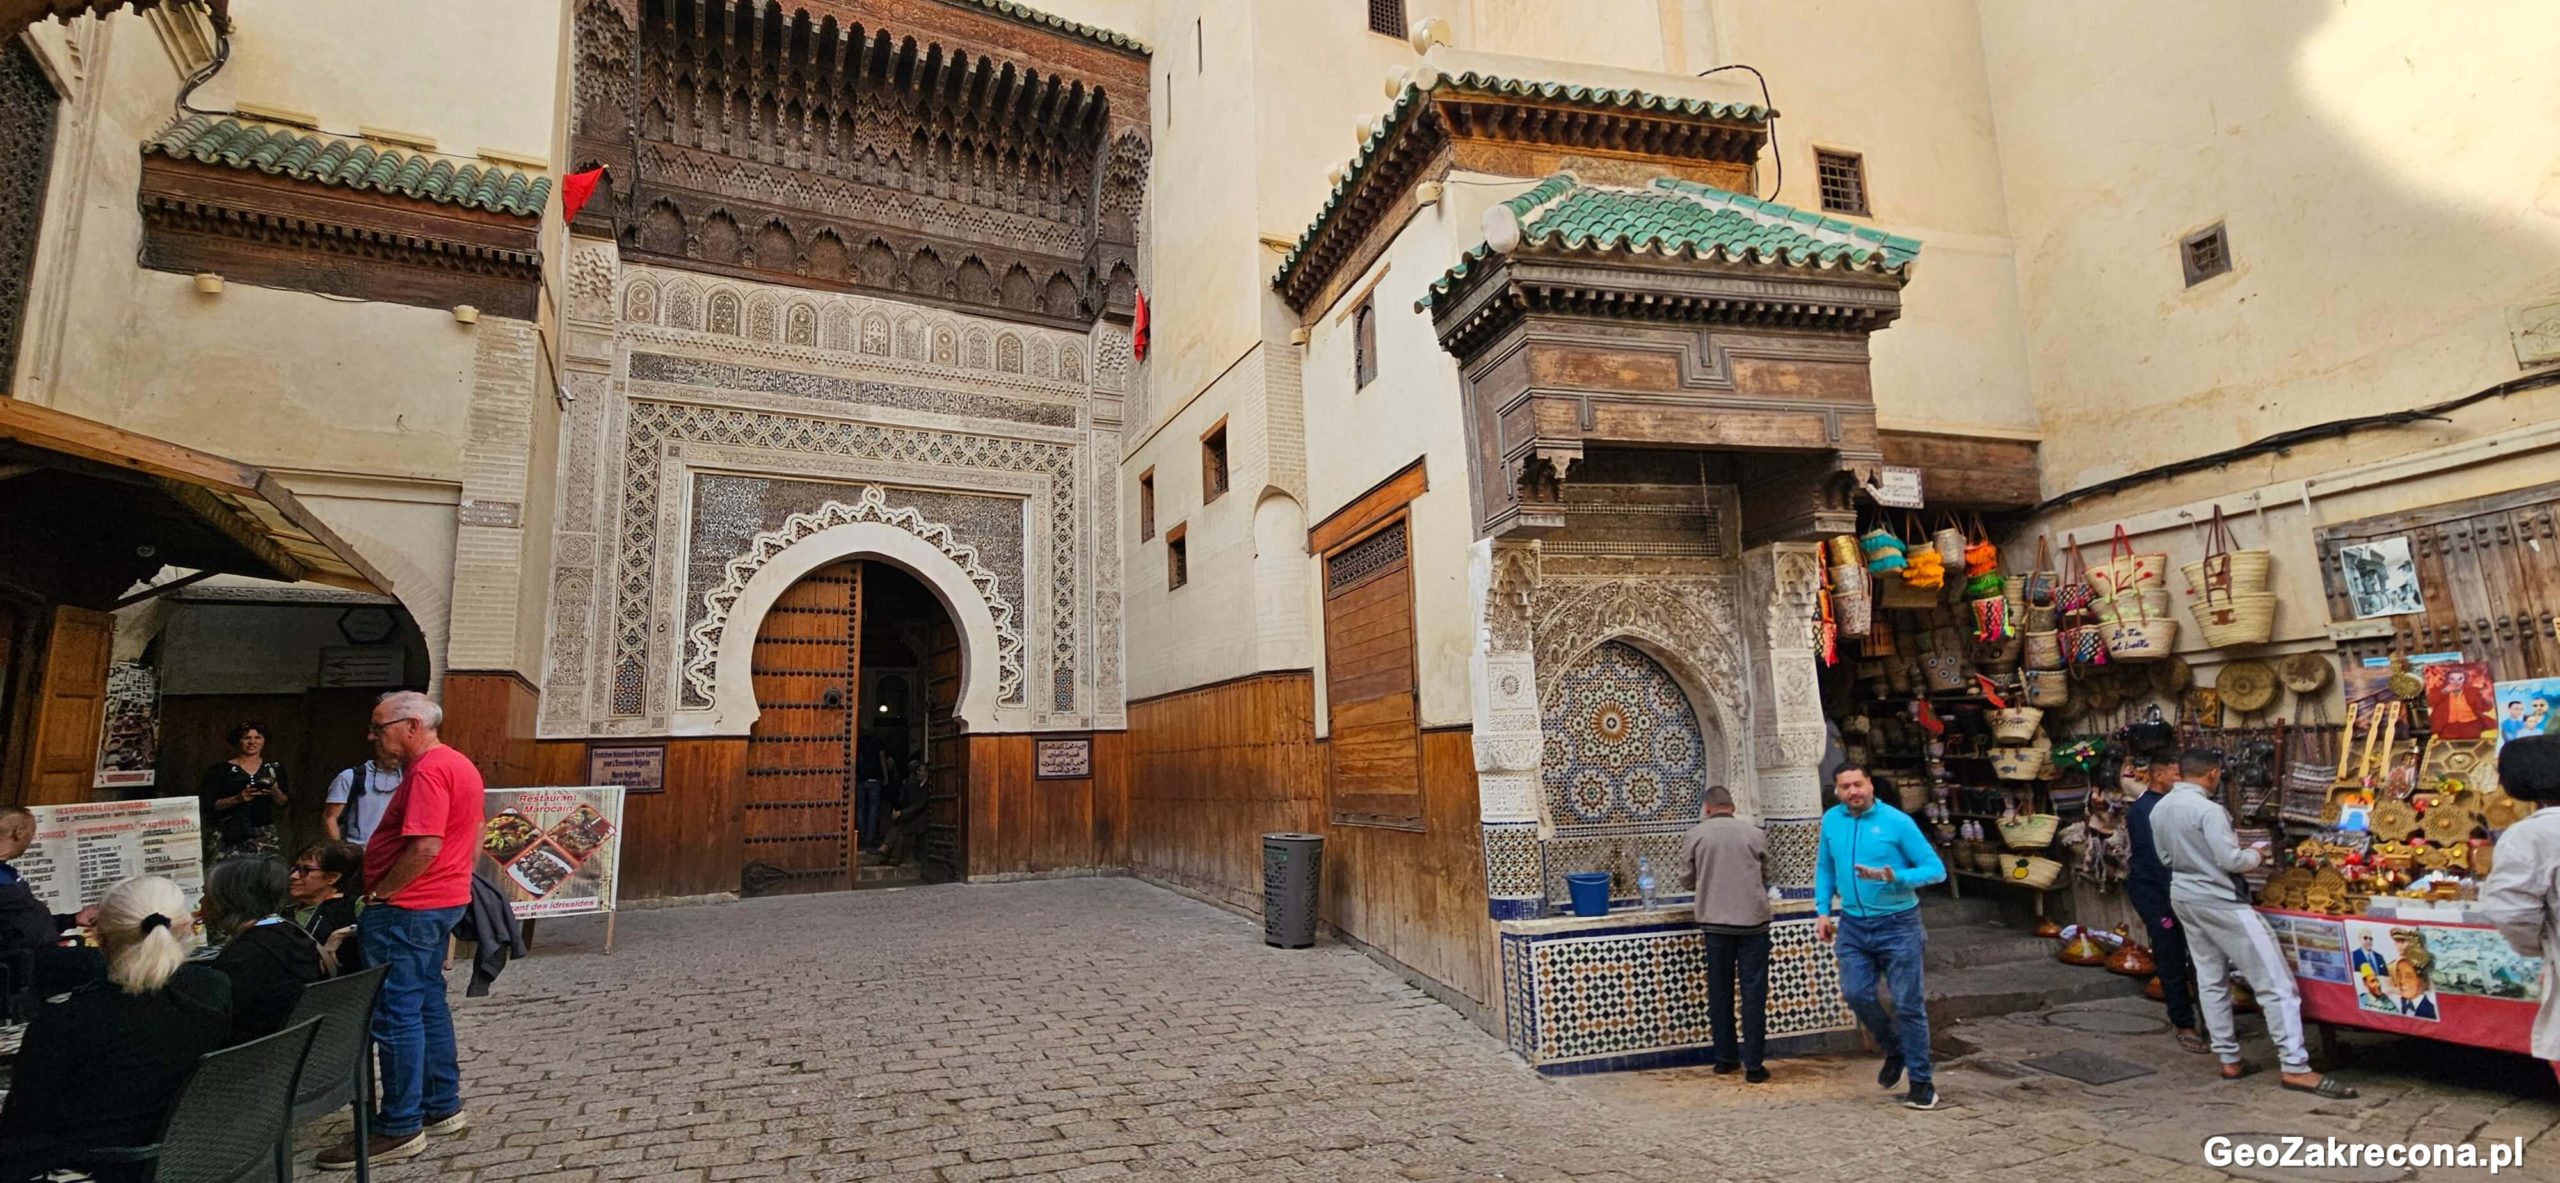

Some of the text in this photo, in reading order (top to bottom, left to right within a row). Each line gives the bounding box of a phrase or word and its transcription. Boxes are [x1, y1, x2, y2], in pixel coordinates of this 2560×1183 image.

[519, 793, 577, 803] Restaurant
[523, 804, 573, 814] Marocain
[549, 900, 594, 909] idrissides
